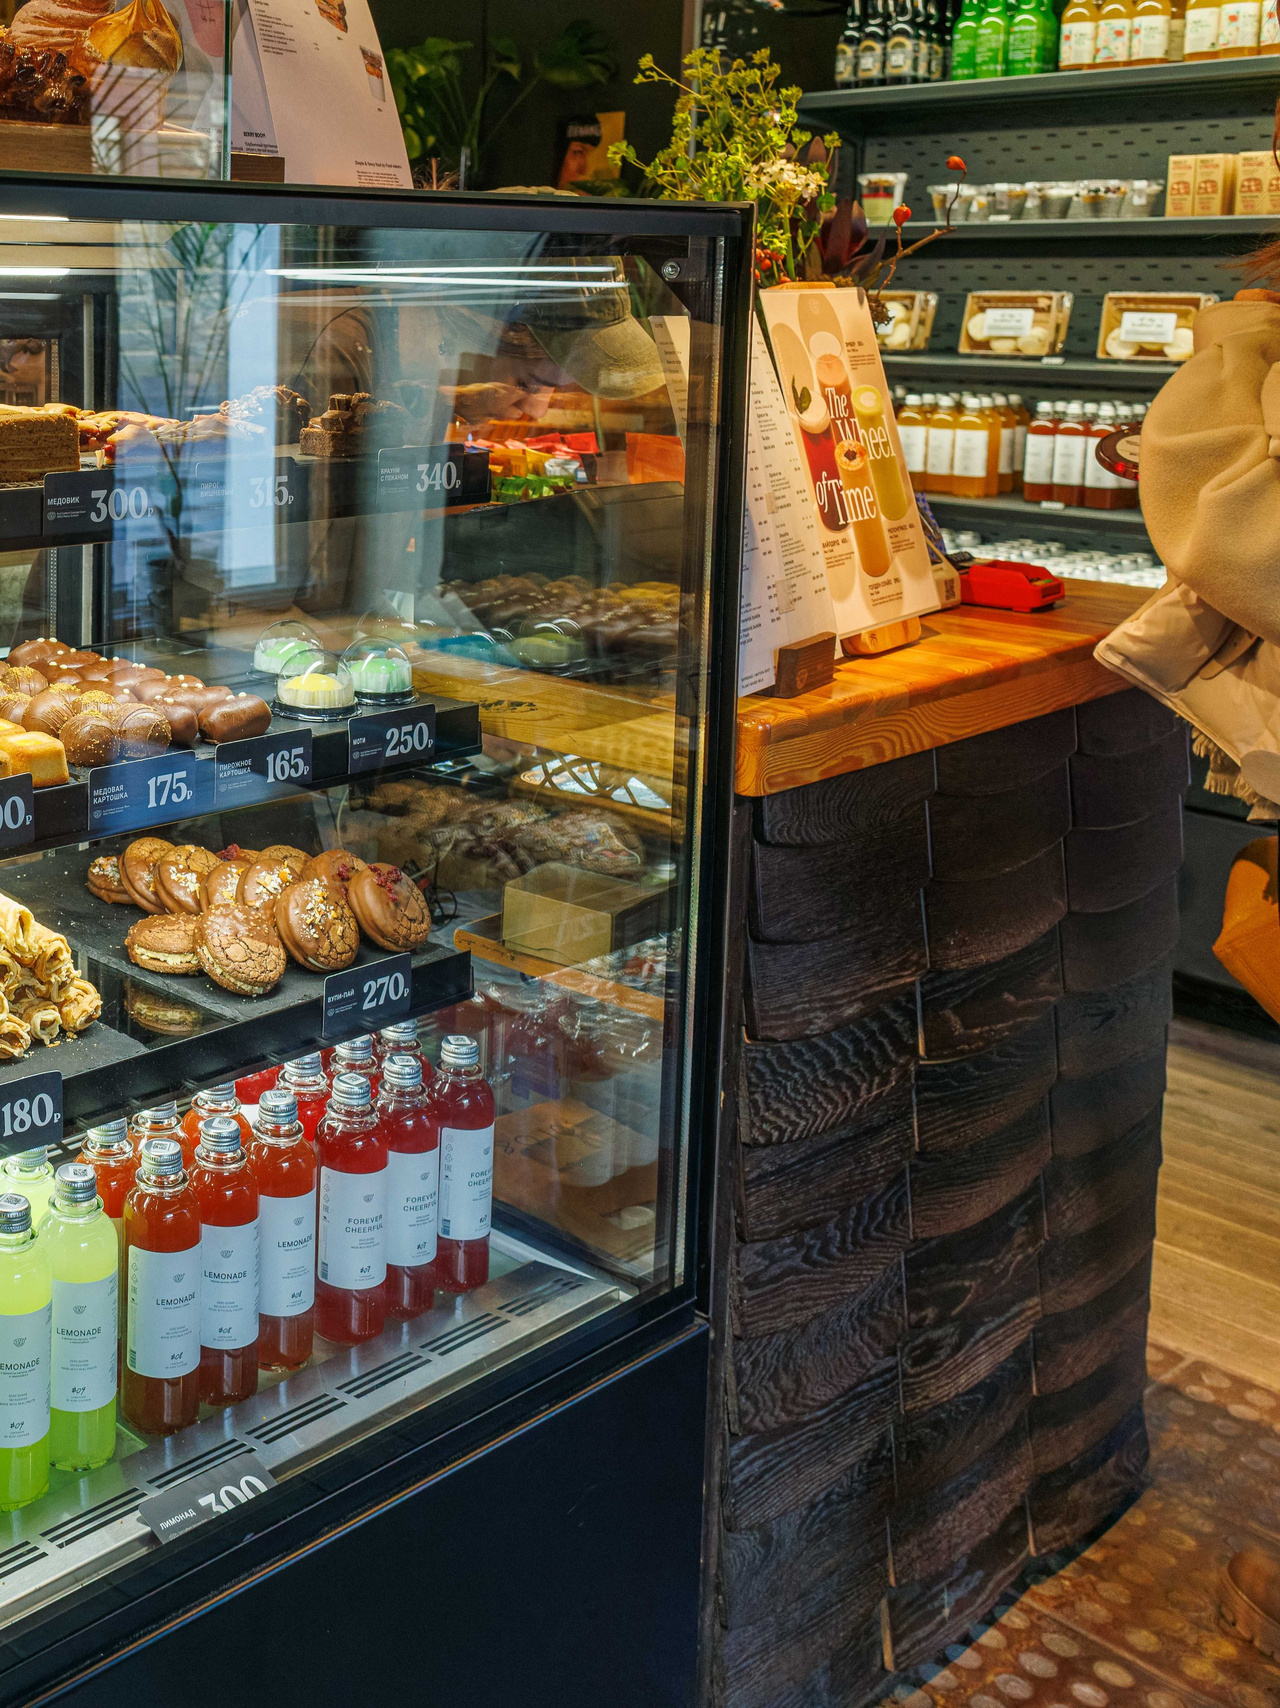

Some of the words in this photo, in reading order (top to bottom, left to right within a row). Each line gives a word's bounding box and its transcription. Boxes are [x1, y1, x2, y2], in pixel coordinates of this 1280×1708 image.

[825, 387, 850, 419] The
[836, 415, 896, 460] Wheel
[380, 467, 400, 475] БРАУНИ
[385, 473, 409, 481] ПЕКАНОМ
[200, 482, 220, 490] ПИРОГ
[200, 488, 234, 498] ВИШНЕВЫЙ
[815, 471, 828, 514] of
[828, 479, 877, 525] Time
[47, 496, 80, 506] МЕДОВИК
[219, 758, 252, 771] ПИРОЖНОЕ
[219, 767, 251, 779] КАРТОШКА
[93, 784, 124, 797] МЕДОВАЯ
[93, 792, 128, 805] КАРТОШКА
[327, 988, 355, 1003] ВУПИ-ПАЙ
[406, 1190, 437, 1203] FOREVER
[347, 1214, 383, 1225] FOREVER
[345, 1222, 383, 1234] CHEERFUL
[277, 1233, 313, 1248] LEMONADE
[204, 1270, 247, 1280] LEMONADE
[156, 1291, 196, 1306] LEMONADE
[56, 1326, 102, 1337] LEMONADE
[71, 1386, 86, 1395] #09
[10, 1421, 25, 1430] #09
[159, 1508, 197, 1530] ЛИМОНАД
